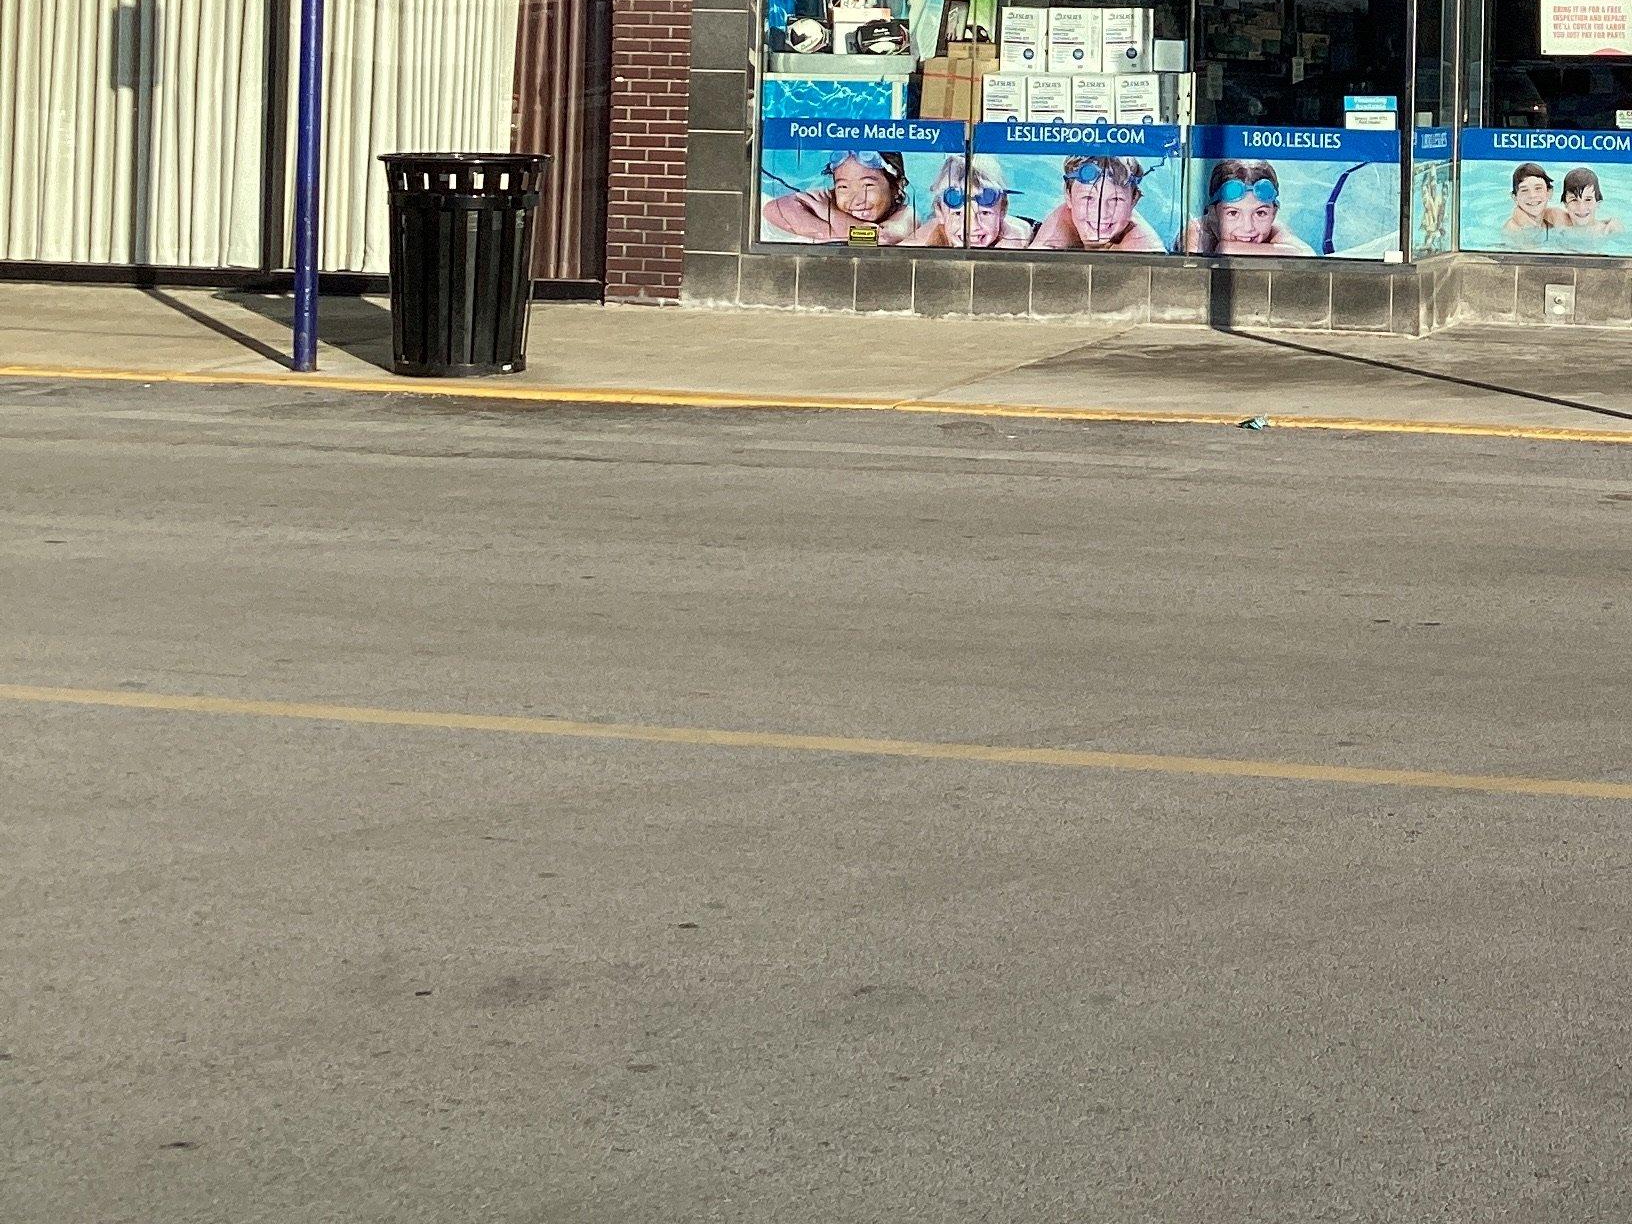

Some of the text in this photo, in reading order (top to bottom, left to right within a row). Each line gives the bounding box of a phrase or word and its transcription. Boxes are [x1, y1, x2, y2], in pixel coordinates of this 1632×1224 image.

[790, 122, 940, 144] Pool Care Made Easy
[1007, 126, 1145, 144] LESLIESPOOL.COM
[1242, 131, 1341, 149] 1.800.LESLIES
[1493, 133, 1631, 151] LESLIESPOOL.COM
